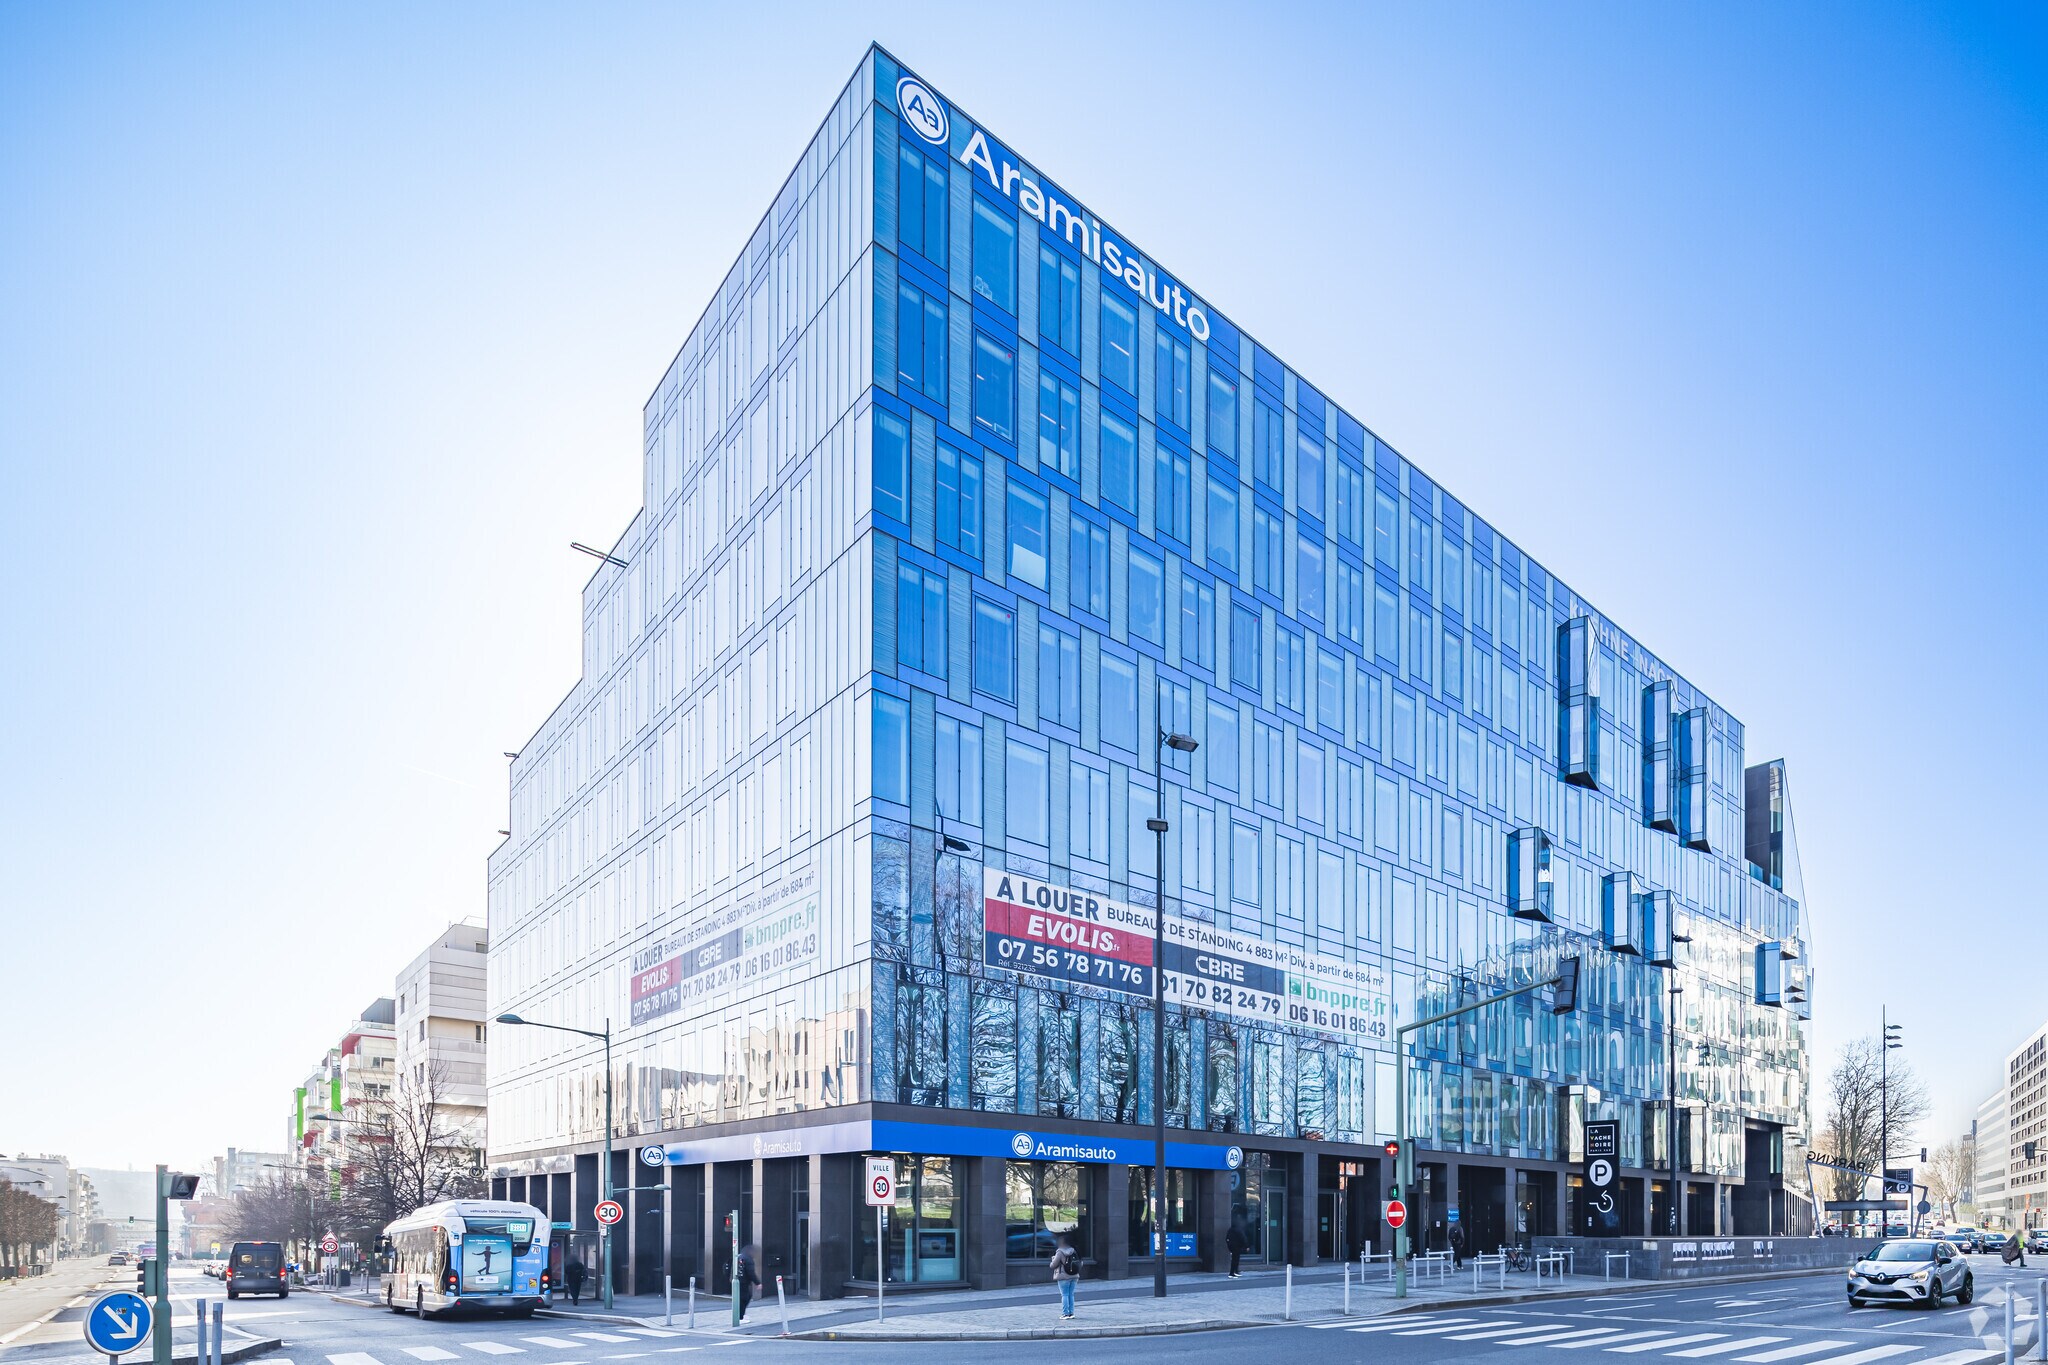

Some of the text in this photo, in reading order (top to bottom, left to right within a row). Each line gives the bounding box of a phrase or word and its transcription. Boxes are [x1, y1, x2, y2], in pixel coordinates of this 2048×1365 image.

[959, 129, 1210, 342] Aramisauto
[633, 956, 639, 974] A
[640, 944, 663, 971] LOUER
[664, 935, 686, 955] BUREAUX
[688, 931, 694, 944] DE
[695, 918, 720, 940] STANDING
[762, 889, 780, 910] partir
[781, 885, 790, 898] de
[790, 878, 804, 894] 684
[756, 900, 816, 946] bnppre.fr
[996, 876, 1015, 901] A
[1022, 881, 1100, 922] LOUER
[1169, 923, 1185, 938] DE
[1188, 928, 1244, 953] STANDING
[1245, 943, 1253, 954] 4
[1255, 946, 1273, 960] 883
[1290, 955, 1308, 969] Div.
[1310, 959, 1315, 971] à
[1317, 963, 1341, 977] partir
[1343, 968, 1354, 979] de
[1356, 971, 1371, 984] 684
[698, 942, 722, 968] CBRE
[746, 933, 816, 978] 06 16 01 86 43
[998, 938, 1143, 984] 07 56 78 71 76
[1195, 955, 1245, 982] CBRE
[682, 962, 740, 1000] 01 70 82 24 79
[1185, 980, 1207, 1000] 70
[1212, 985, 1232, 1006] 82
[1238, 992, 1257, 1010] 24
[1261, 996, 1281, 1015] 79
[633, 1002, 642, 1017] 07
[642, 998, 650, 1014] 56
[651, 994, 660, 1010] 78
[668, 986, 678, 1004] 76
[1306, 981, 1386, 1017] bnppre.fr
[1290, 1004, 1308, 1023] 06
[1312, 1008, 1328, 1026] 16
[1331, 1012, 1346, 1030] 01
[1350, 1016, 1367, 1034] 86
[1368, 1021, 1386, 1038] 43
[763, 1140, 802, 1154] Aramisauto
[1035, 1142, 1116, 1160] Aramisauto
[876, 1182, 886, 1192] 30
[1594, 1164, 1608, 1182] P
[600, 1208, 617, 1217] 30
